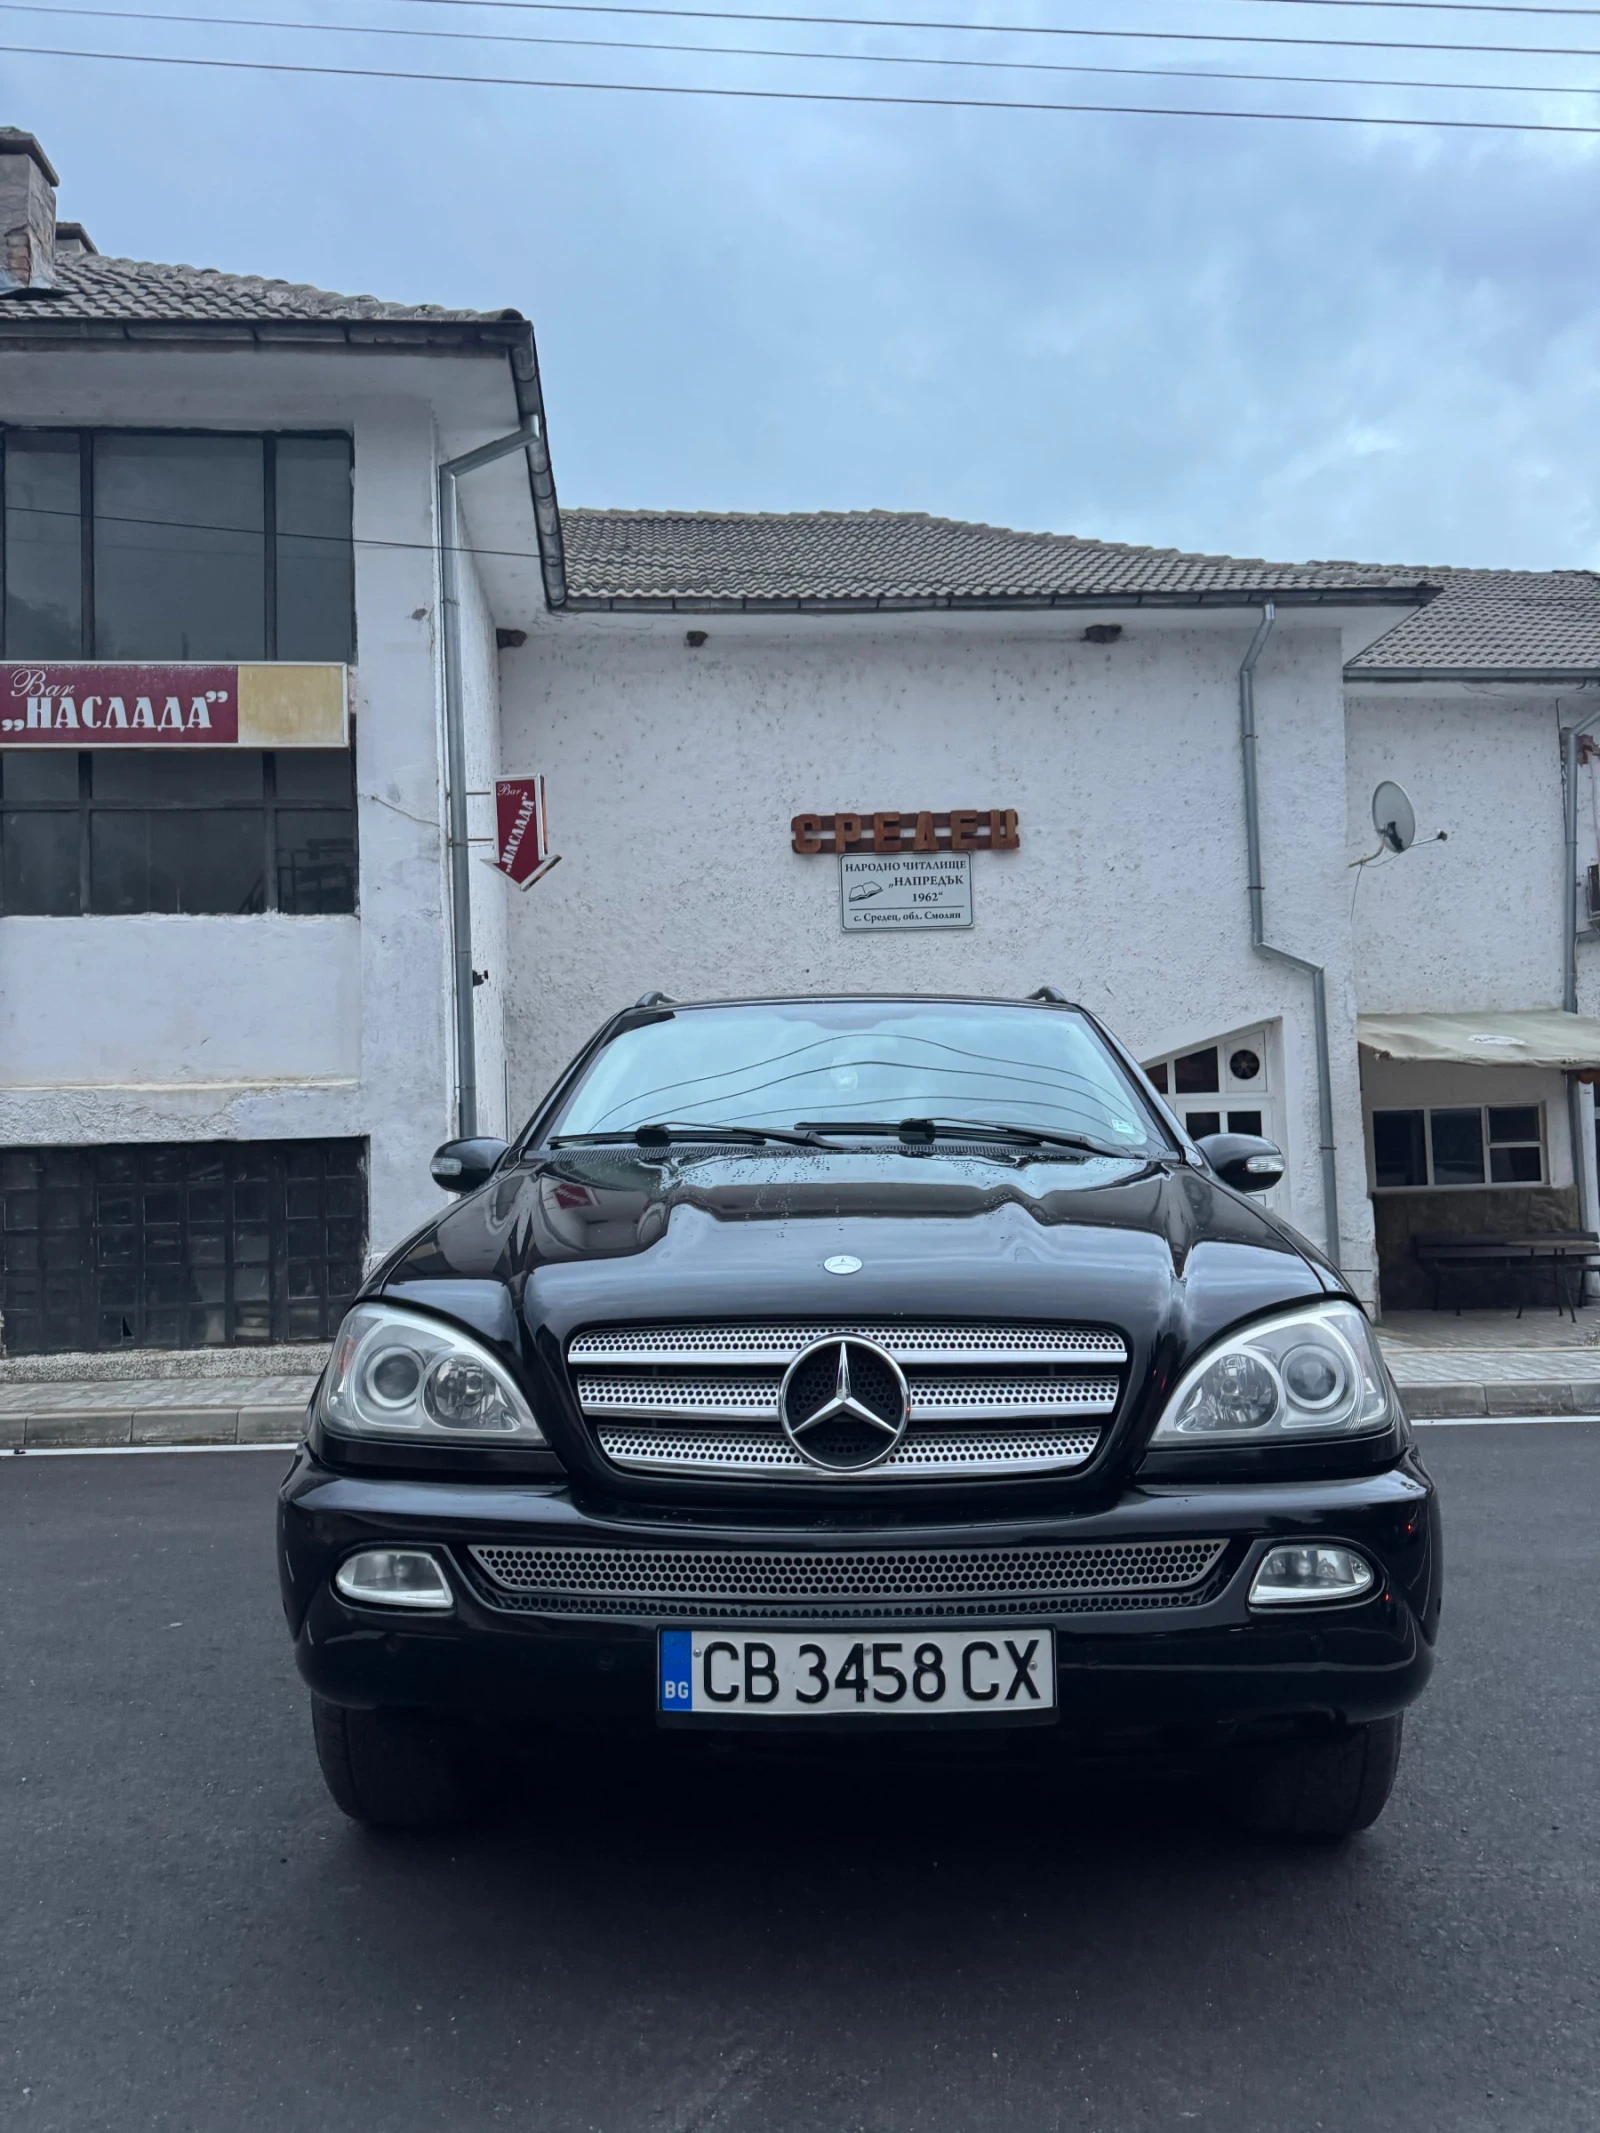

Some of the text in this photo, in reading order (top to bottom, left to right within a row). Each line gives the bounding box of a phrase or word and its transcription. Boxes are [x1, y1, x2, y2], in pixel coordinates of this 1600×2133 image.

[10, 667, 75, 697] Bar
[497, 784, 522, 796] Bar
[793, 809, 1019, 854] СРЕДЕЦ
[845, 860, 967, 873] НАРОДНО ЧИТАЛИЩЕ
[853, 910, 961, 924] с. Средец, обл. Смолян
[703, 1639, 1042, 1704] CB 3458 CX
[664, 1680, 690, 1700] BG
